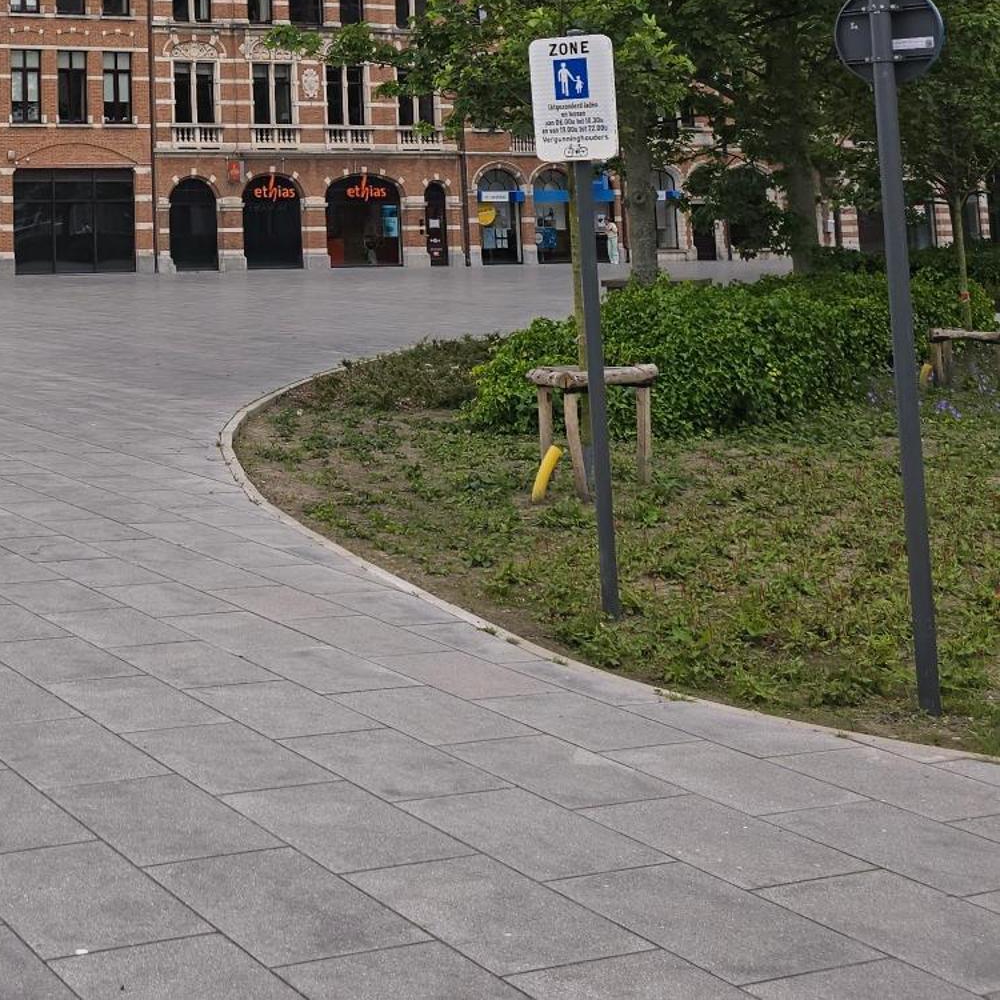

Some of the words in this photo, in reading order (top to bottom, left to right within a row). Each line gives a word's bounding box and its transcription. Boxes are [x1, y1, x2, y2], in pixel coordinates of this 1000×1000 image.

[549, 41, 589, 56] ZONE
[254, 174, 295, 202] ethias
[346, 174, 387, 202] ethias
